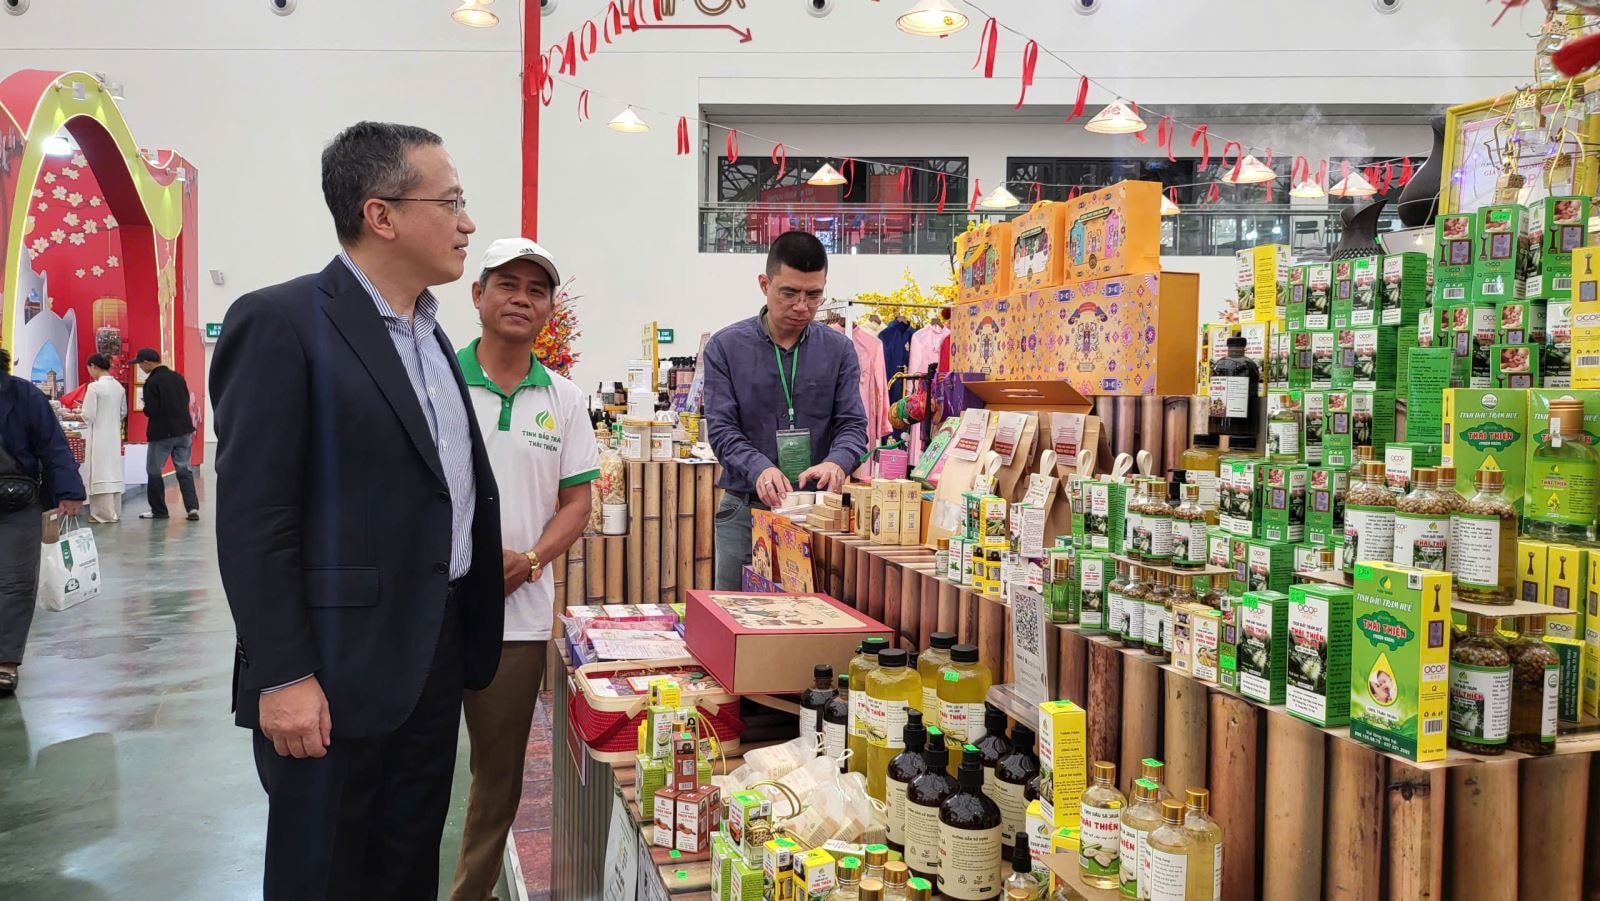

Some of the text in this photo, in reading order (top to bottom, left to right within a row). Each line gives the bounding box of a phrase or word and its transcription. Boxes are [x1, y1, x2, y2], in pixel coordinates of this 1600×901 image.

[538, 432, 550, 440] DẦU
[1468, 430, 1513, 442] THÁI THIỆN
[529, 440, 542, 448] THÁI
[1357, 593, 1371, 603] TINH
[1292, 627, 1305, 637] THÁI
[1363, 618, 1381, 632] THÁI
[1383, 622, 1407, 639] THIỆN
[1424, 664, 1446, 674] OCOP
[1093, 820, 1119, 833] THIỆN
